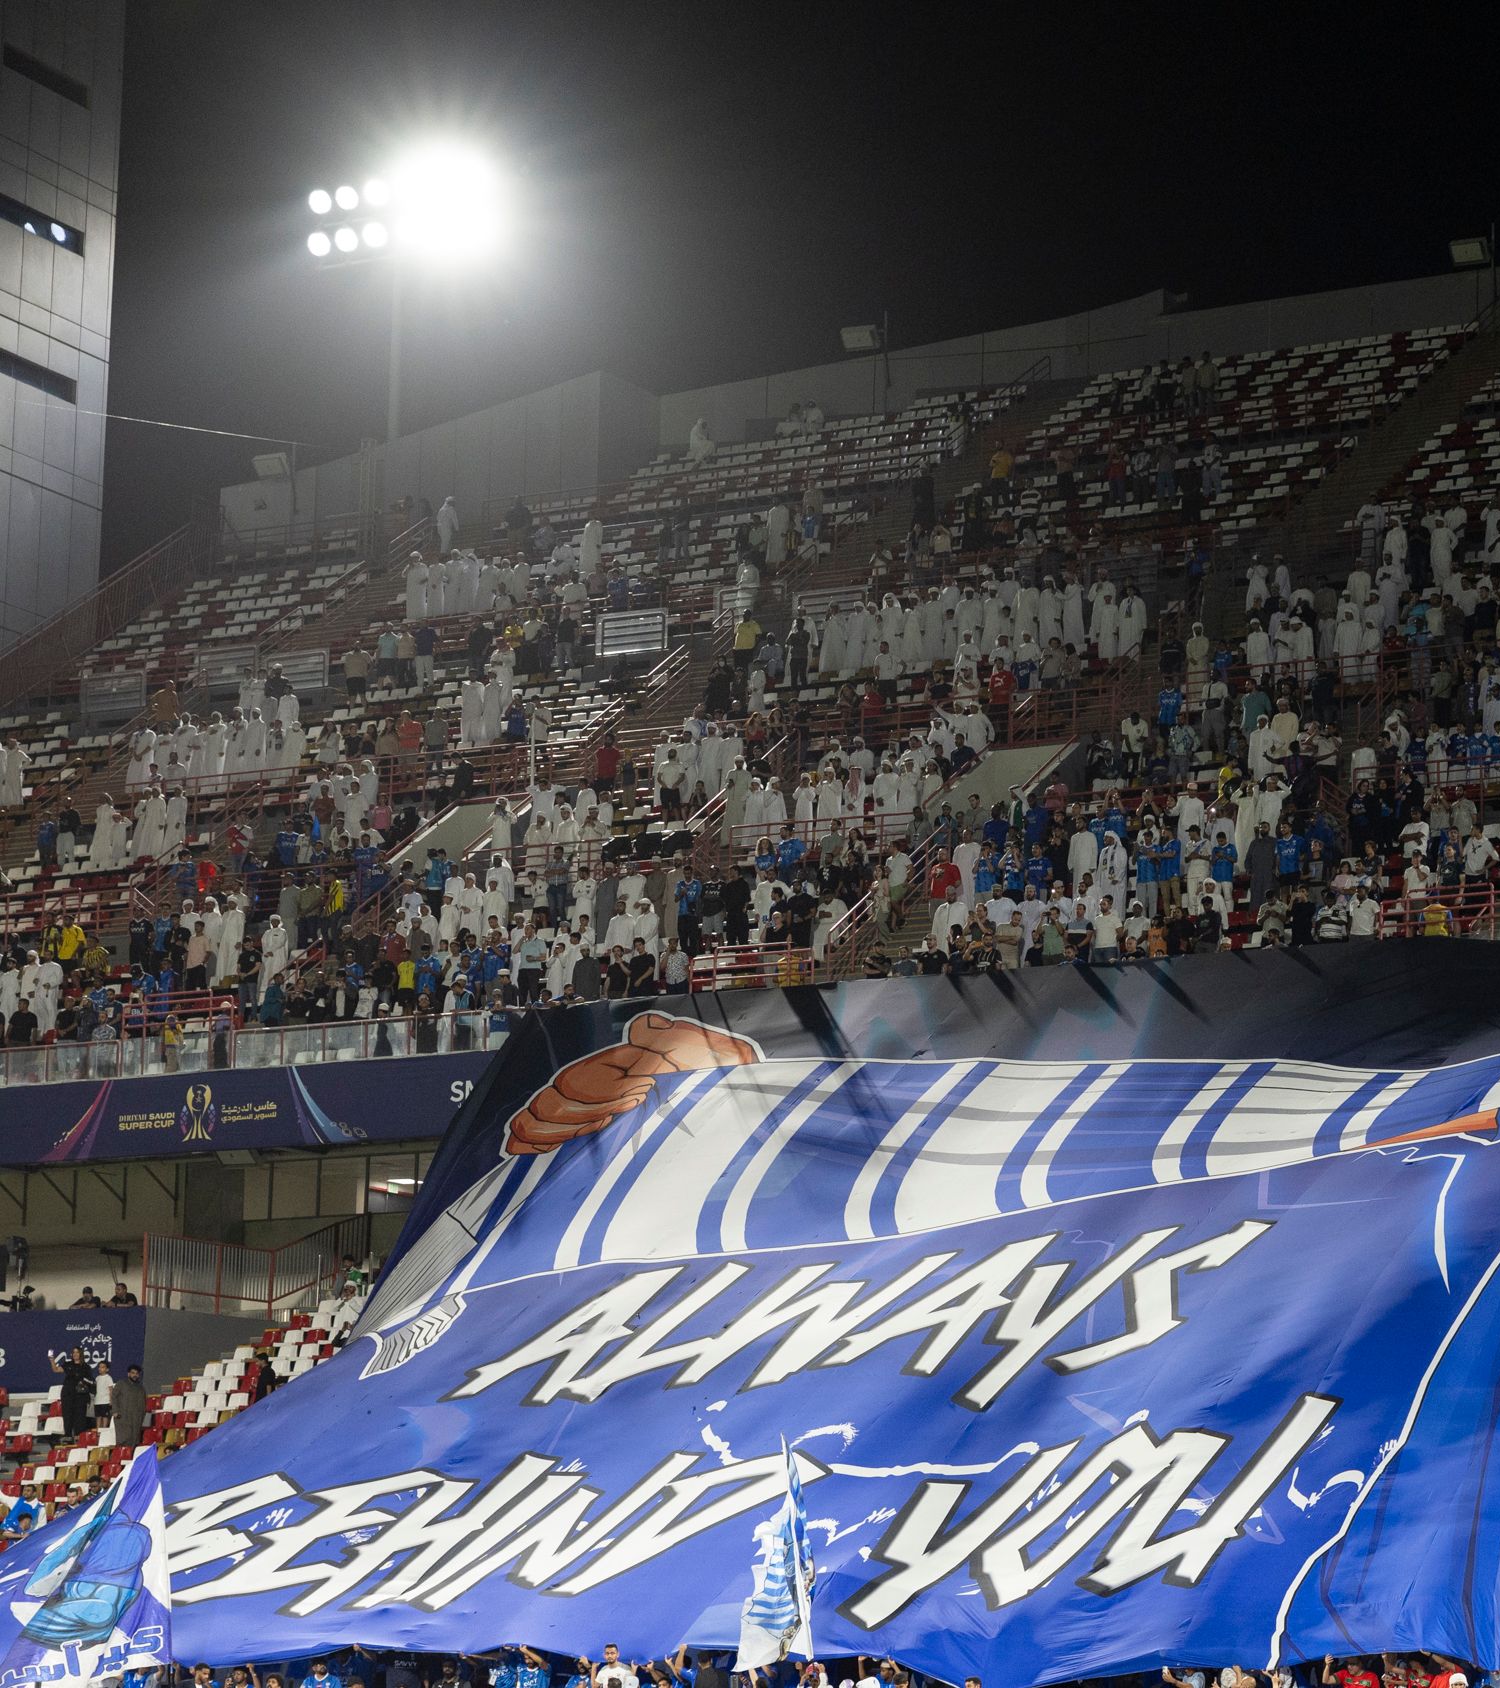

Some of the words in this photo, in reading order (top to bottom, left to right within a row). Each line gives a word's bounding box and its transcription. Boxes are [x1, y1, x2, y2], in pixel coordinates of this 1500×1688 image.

[118, 1121, 153, 1131] SUPER
[153, 1119, 175, 1129] CUP
[149, 1112, 175, 1120] SAUDI
[440, 1220, 1276, 1411] ALWAYS
[165, 1451, 835, 1618] BEHIND
[836, 1394, 1344, 1632] YOU
